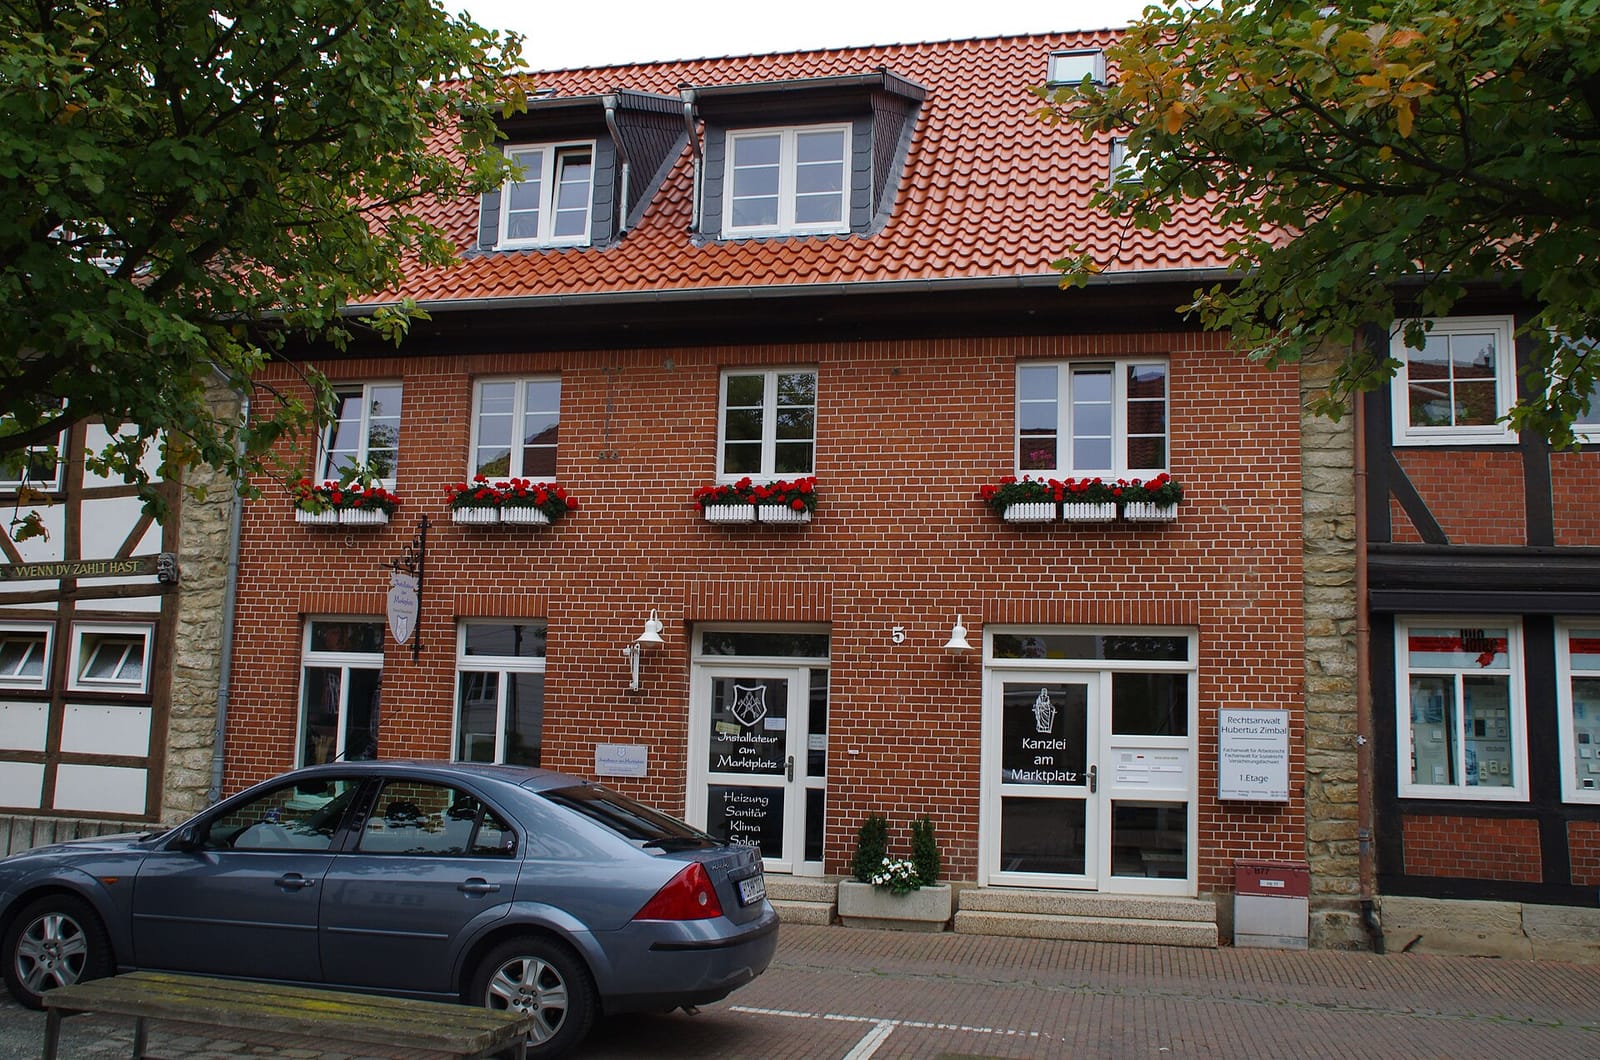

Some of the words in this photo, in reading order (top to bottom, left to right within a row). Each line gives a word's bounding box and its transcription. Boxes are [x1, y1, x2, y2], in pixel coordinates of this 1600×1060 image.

[109, 561, 139, 573] HAST
[892, 626, 904, 643] 5
[1227, 716, 1280, 724] Rechtsanwalt
[1221, 726, 1258, 735] Hubertus
[1259, 726, 1287, 735] Zimbal
[717, 732, 778, 743] Installateur
[1022, 738, 1066, 750] Kanzlei
[738, 746, 756, 755] am
[716, 755, 777, 770] Marktplatz
[1033, 754, 1054, 765] am
[1011, 769, 1077, 783] Marktplatz
[723, 791, 769, 807] Heizung
[725, 806, 767, 818] Sanitär
[730, 821, 761, 832] Klima
[730, 835, 761, 846] Solar
